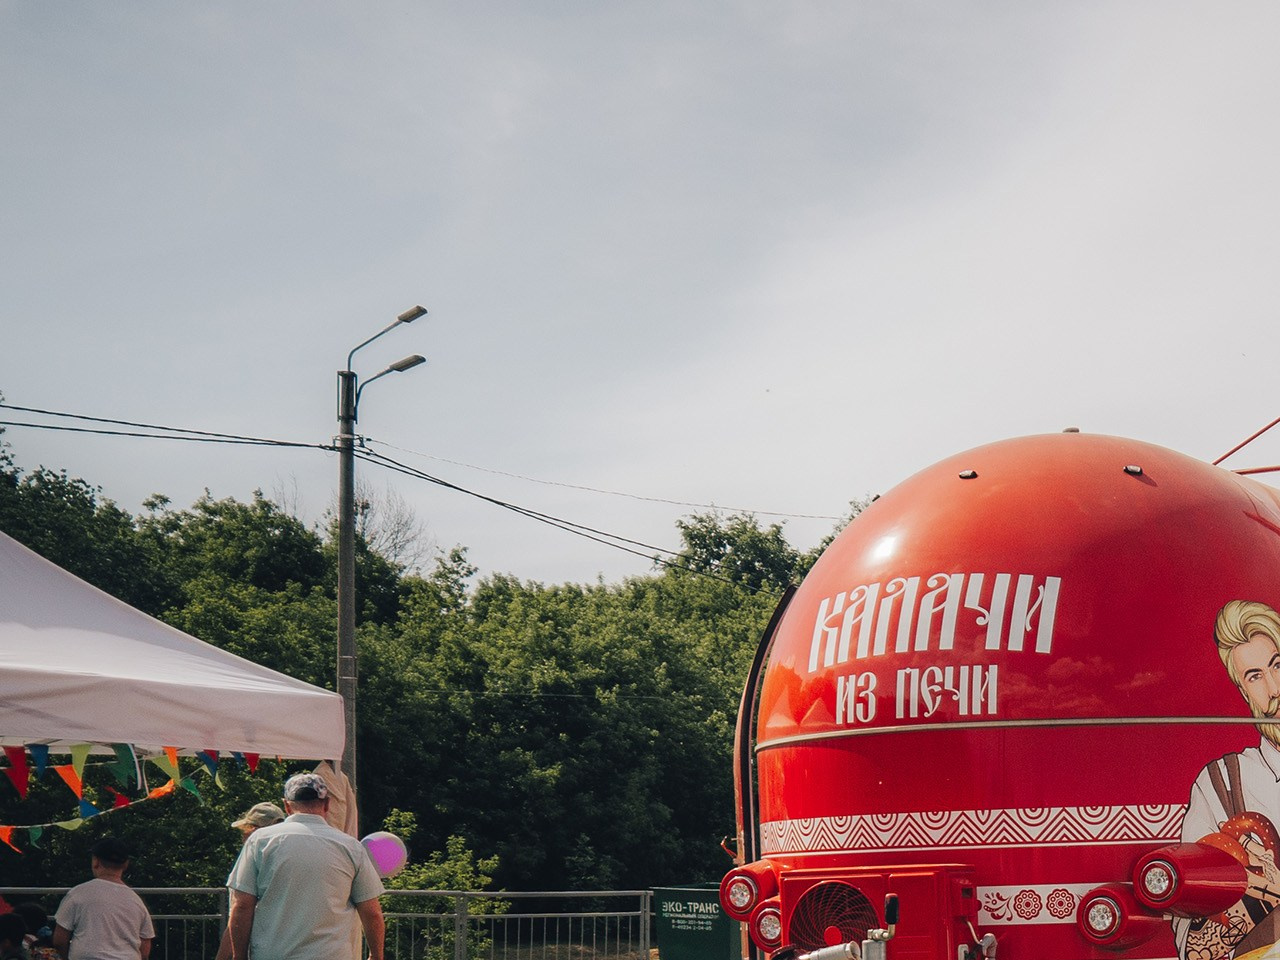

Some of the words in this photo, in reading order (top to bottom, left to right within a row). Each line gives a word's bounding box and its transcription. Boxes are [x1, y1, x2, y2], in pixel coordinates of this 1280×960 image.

[808, 573, 1061, 673] КАЛАЧИ
[836, 671, 877, 725] ИЗ
[896, 664, 998, 719] ПЕЧИ
[662, 901, 720, 914] ЭКО-ТРАНС
